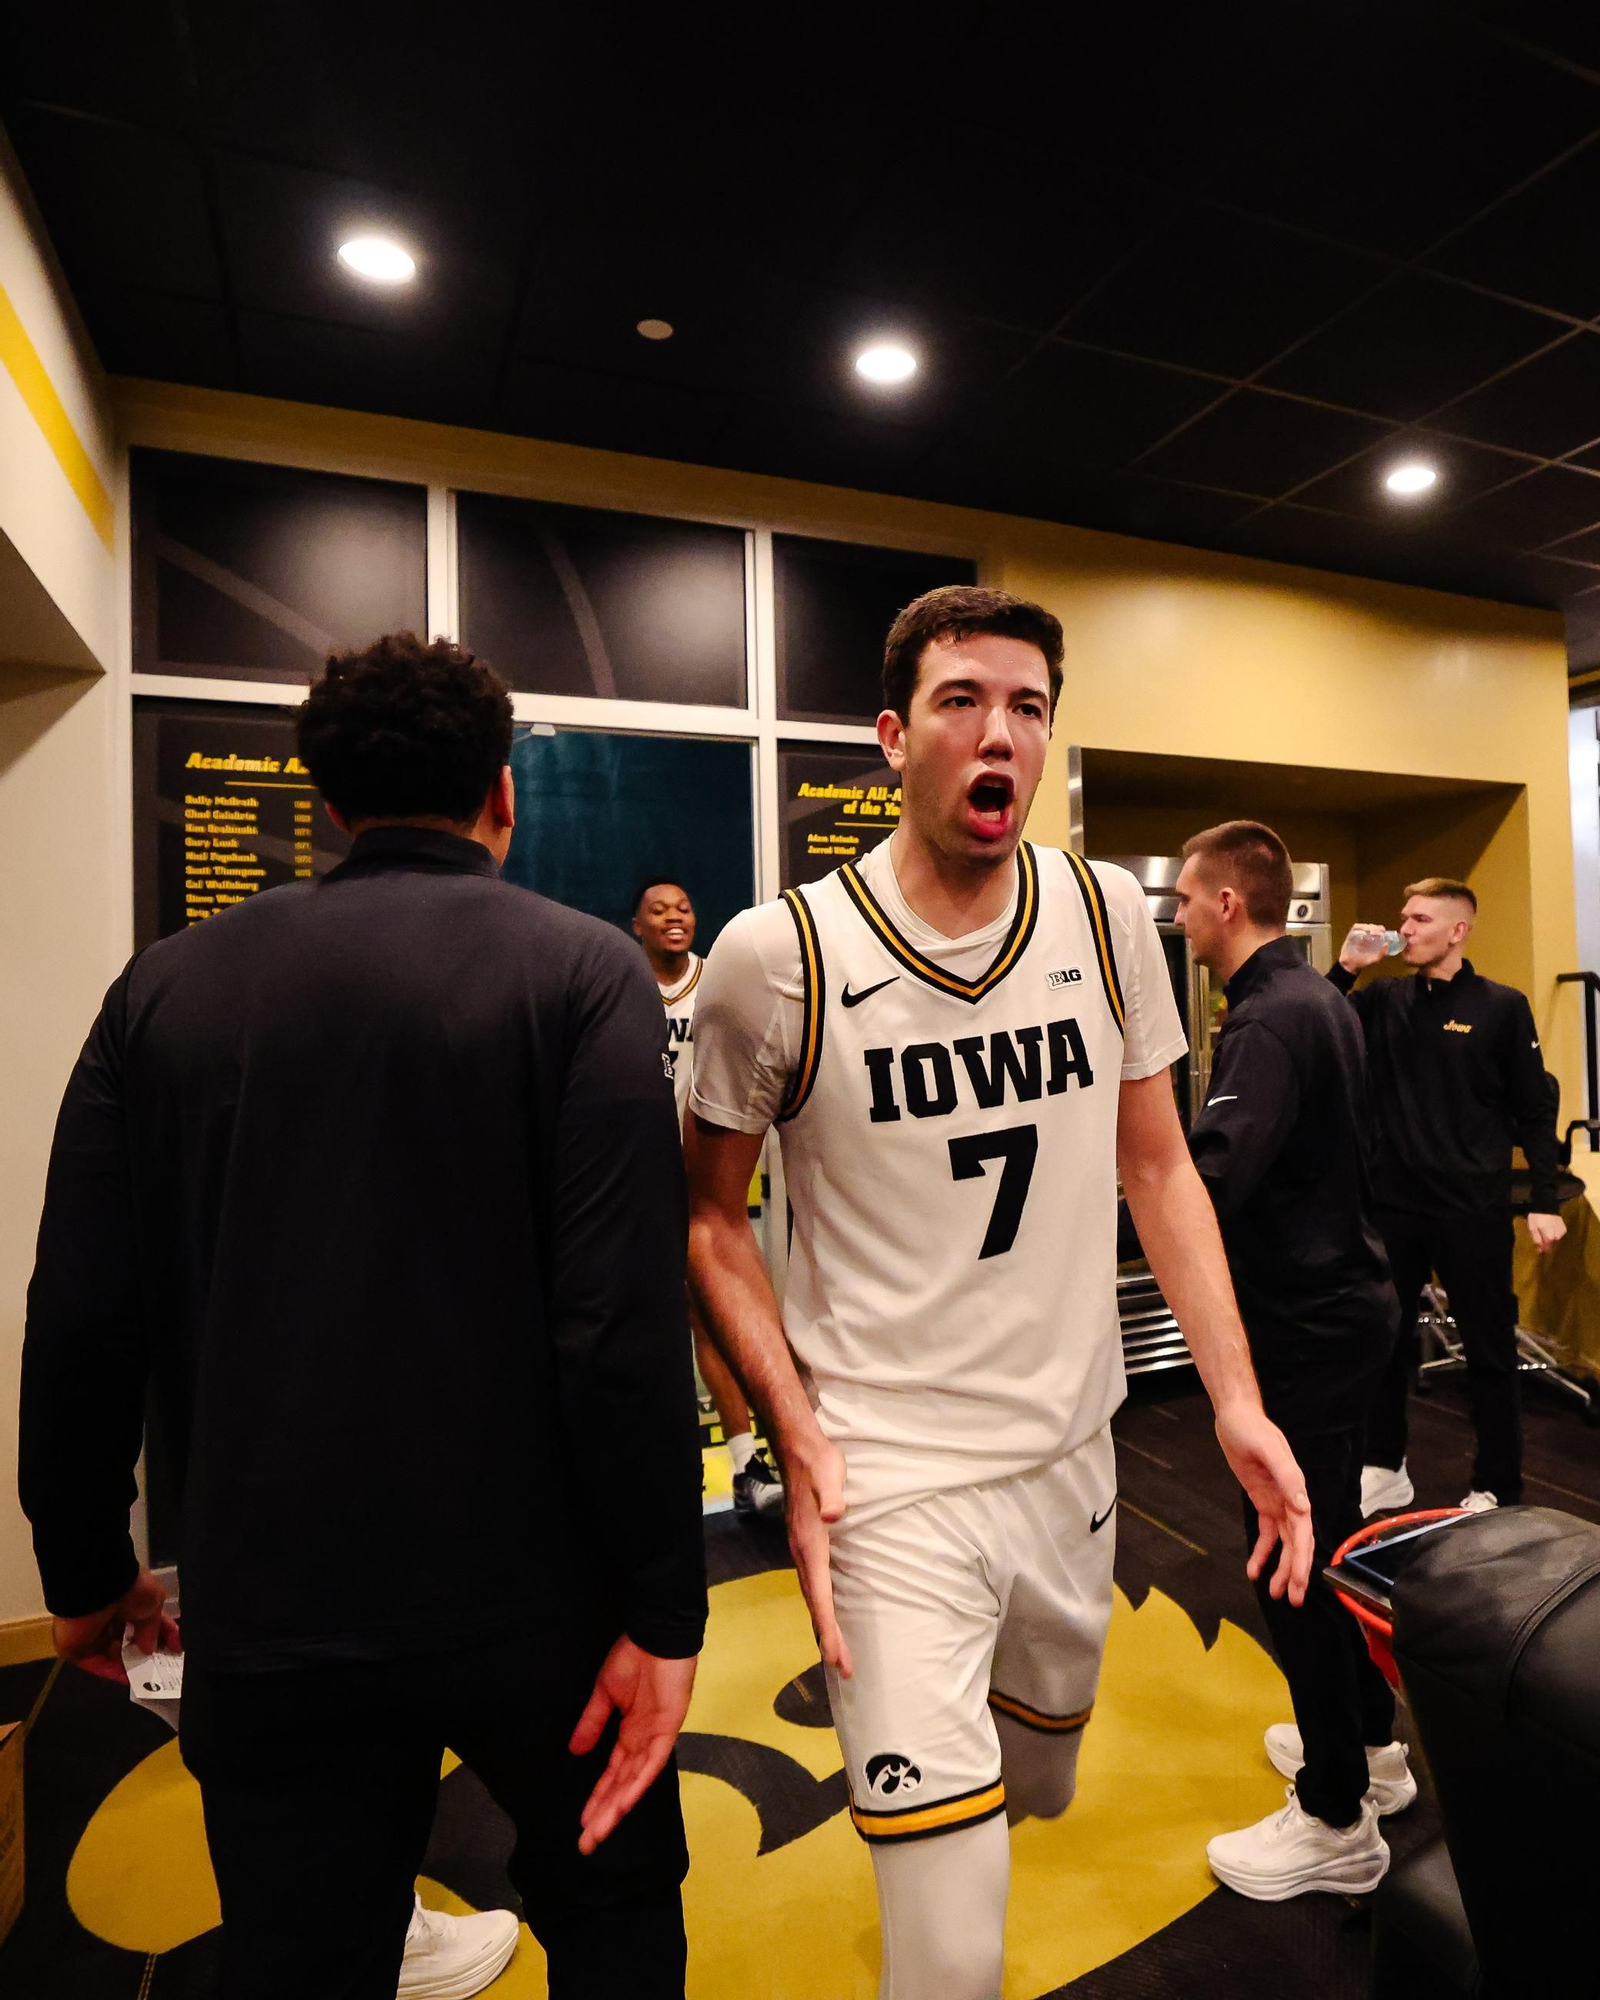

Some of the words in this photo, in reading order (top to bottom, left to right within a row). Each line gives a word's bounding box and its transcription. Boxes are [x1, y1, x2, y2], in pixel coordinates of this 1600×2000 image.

[185, 752, 280, 773] Academic
[798, 782, 864, 800] Academic
[843, 800, 858, 814] of
[860, 801, 881, 815] the
[1048, 968, 1082, 987] BIG
[863, 1017, 1094, 1123] IOWA
[947, 1123, 1039, 1260] 7
